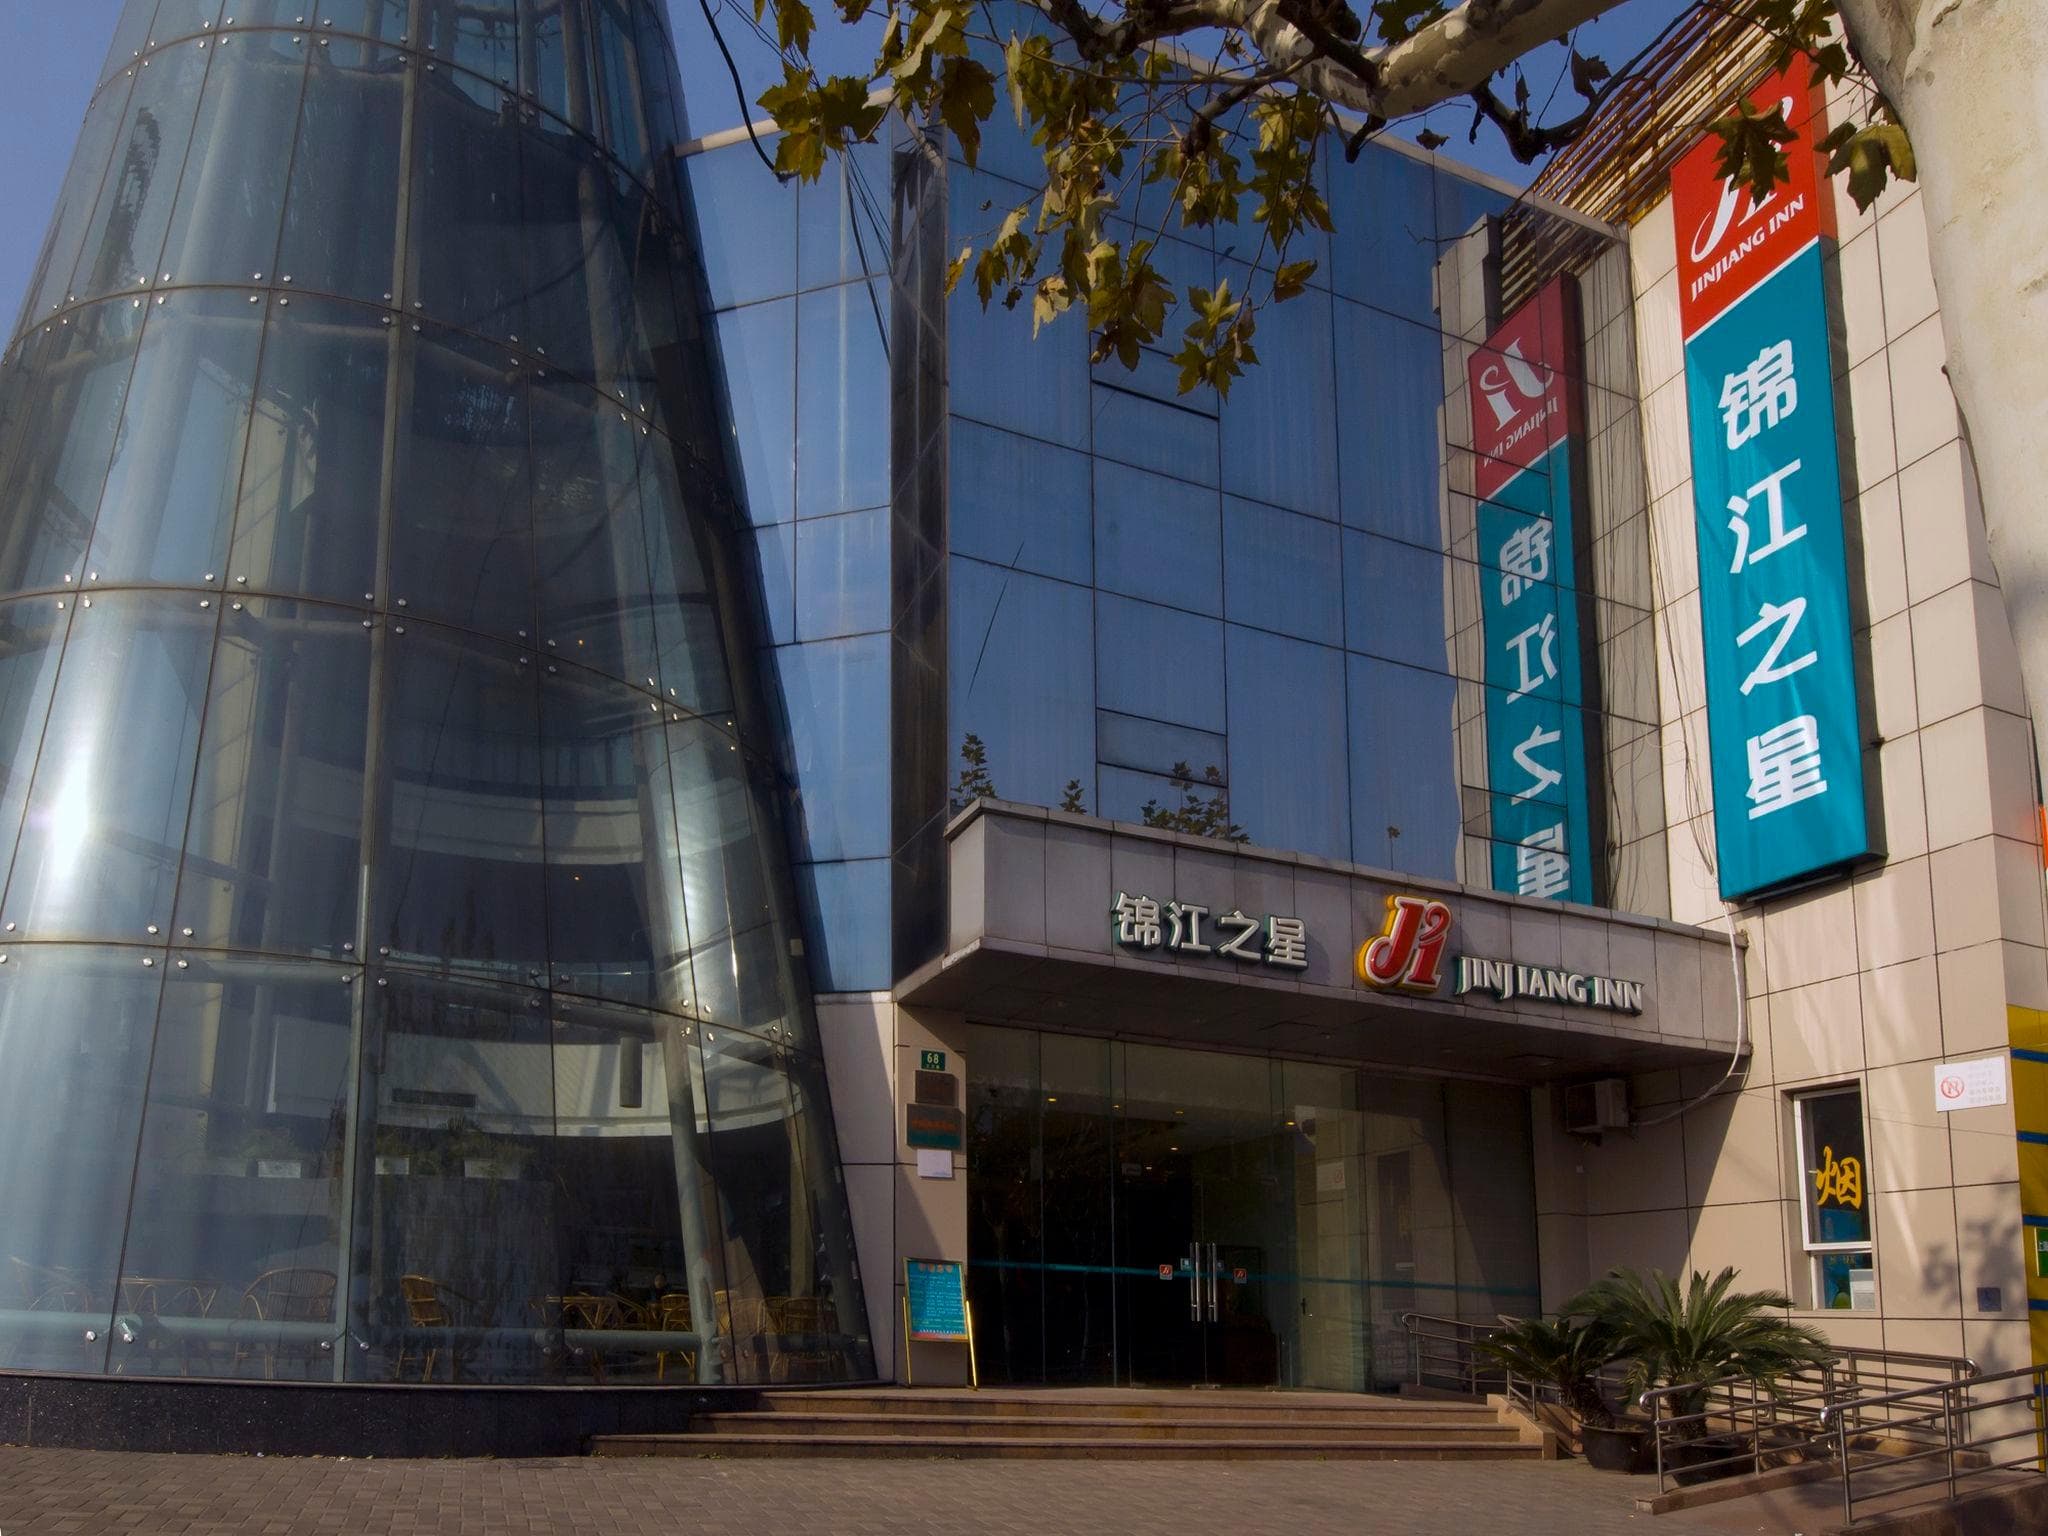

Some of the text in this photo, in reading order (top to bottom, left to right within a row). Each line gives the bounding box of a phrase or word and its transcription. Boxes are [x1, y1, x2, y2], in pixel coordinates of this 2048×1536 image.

[1691, 192, 1805, 302] JINJIANG INN
[1718, 338, 1828, 821] 锦江之星
[1111, 890, 1308, 970] 锦江之星
[1456, 955, 1645, 1015] JINJIANG INN
[926, 1052, 940, 1064] 68
[1815, 1145, 1862, 1209] 烟
